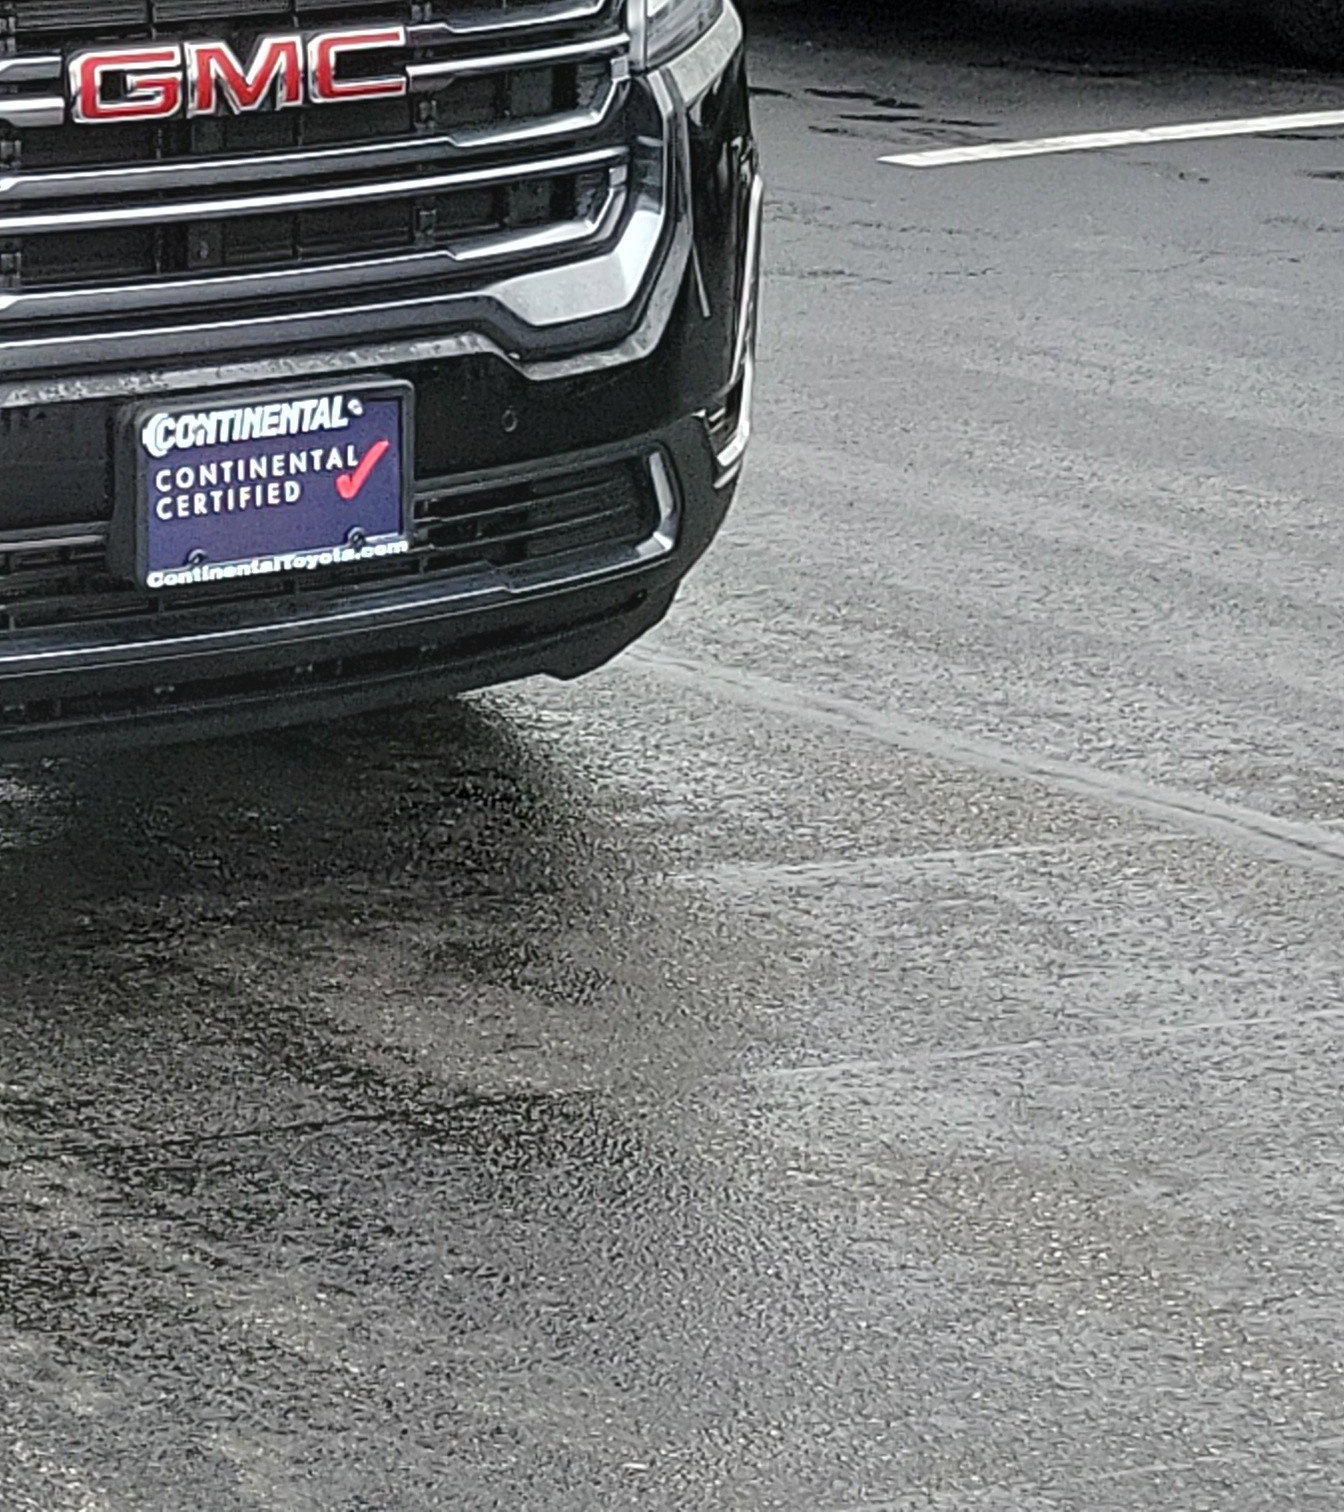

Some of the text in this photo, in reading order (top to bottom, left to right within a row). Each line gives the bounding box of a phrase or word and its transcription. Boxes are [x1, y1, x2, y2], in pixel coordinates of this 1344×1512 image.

[69, 25, 406, 124] GMC
[142, 395, 349, 457] CONTINENTAL
[156, 445, 359, 492] CONTINENTAL
[156, 481, 301, 520] CERTIFIED
[146, 539, 409, 588] ContinentalToyota.com
